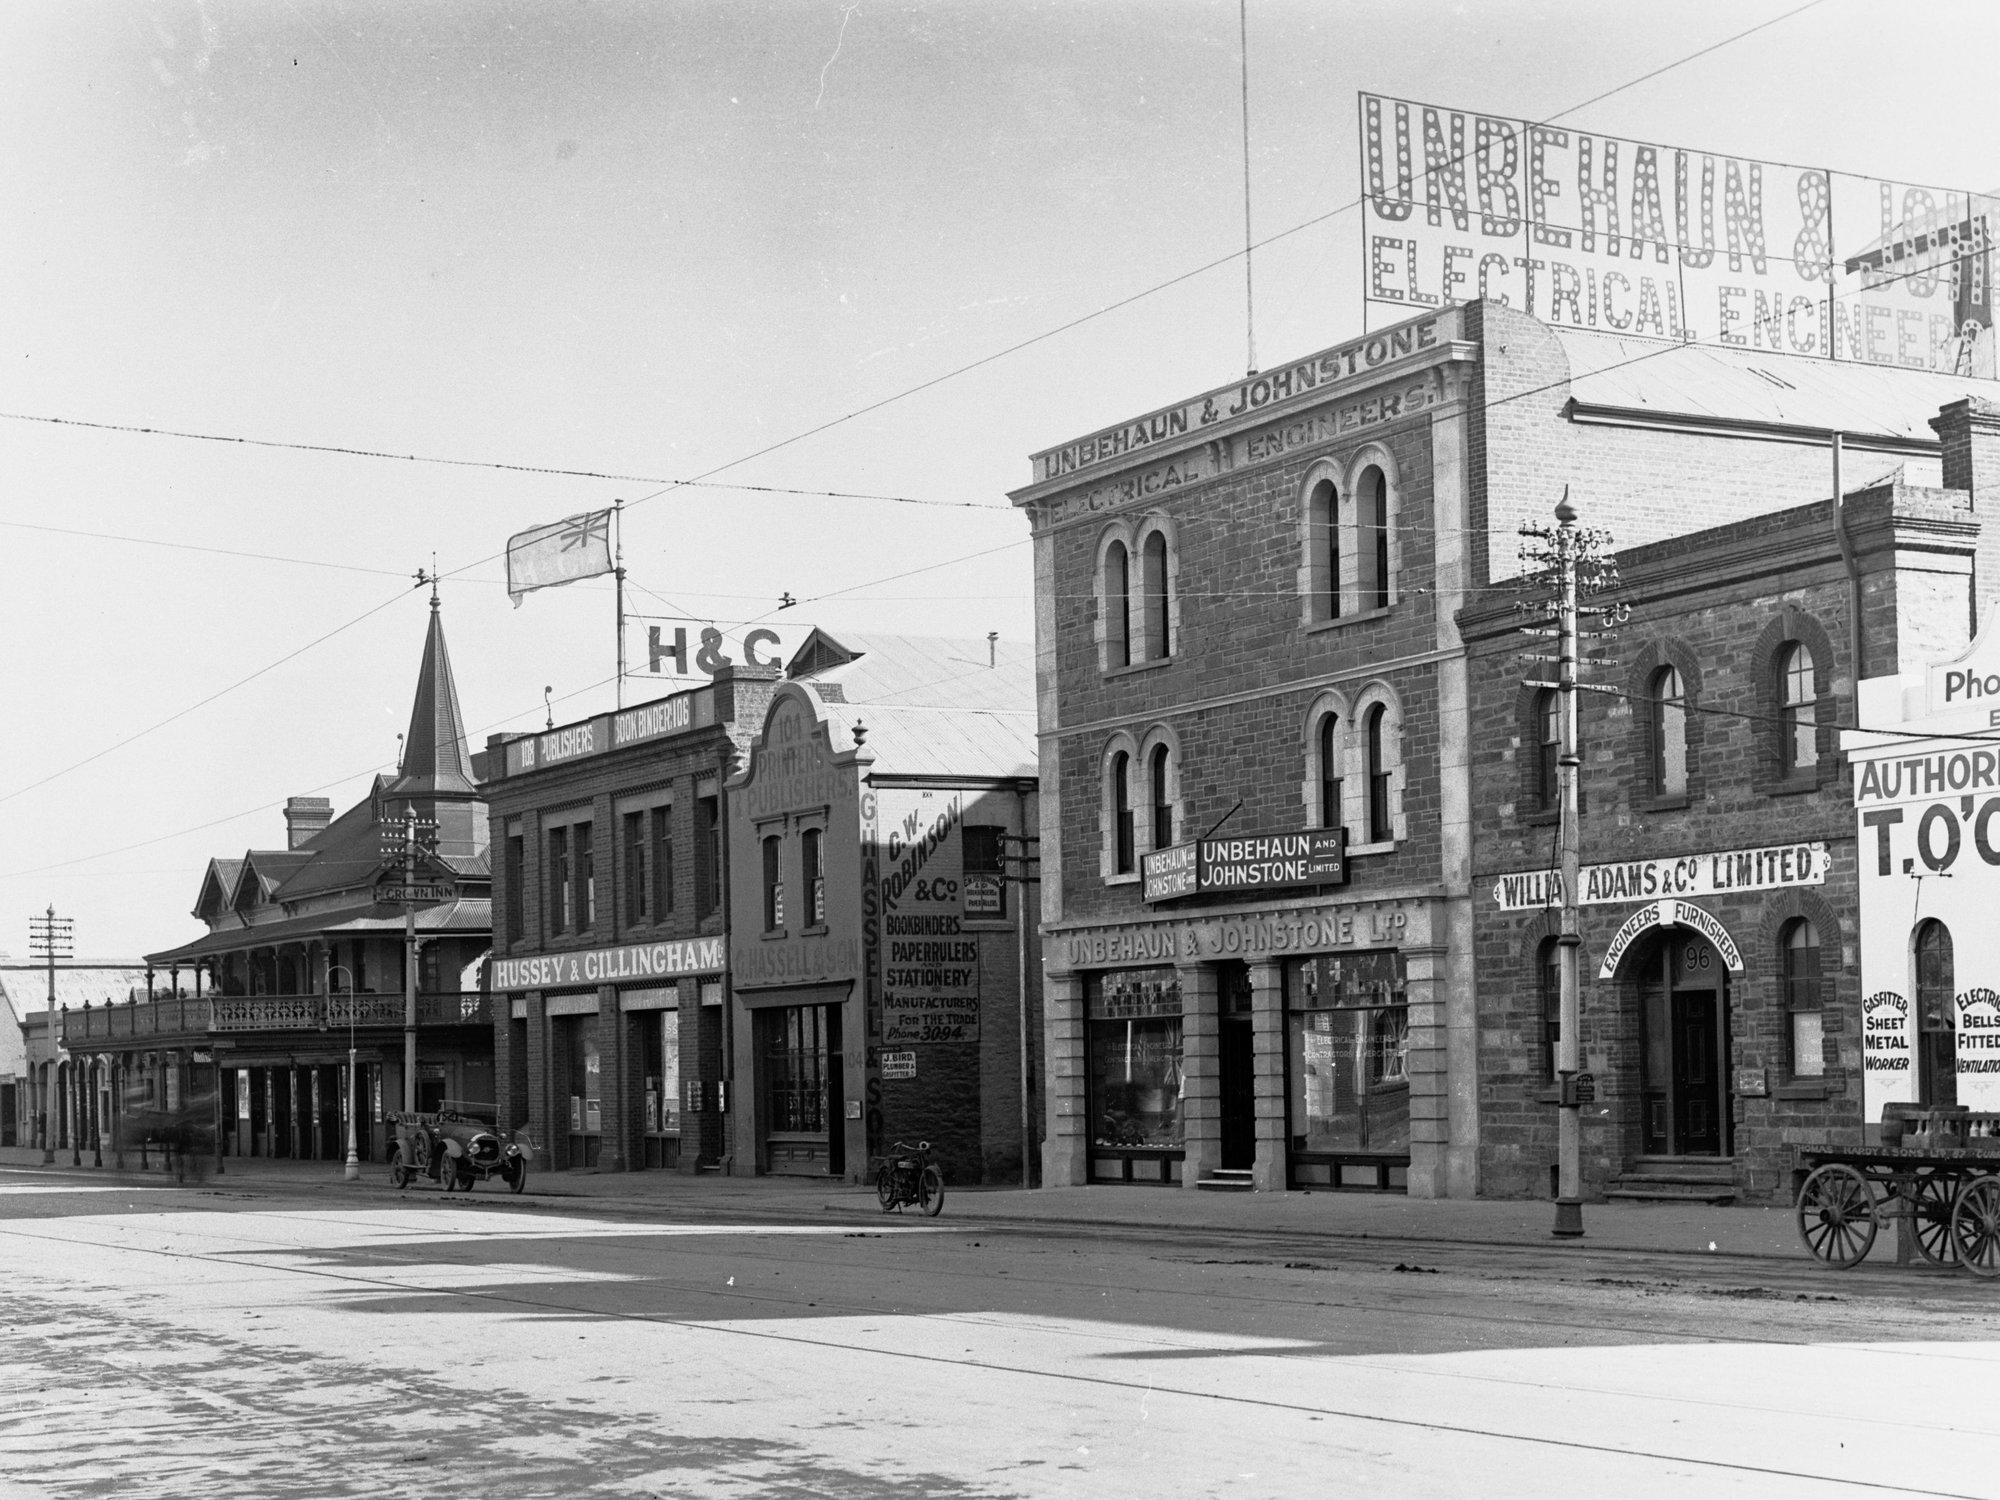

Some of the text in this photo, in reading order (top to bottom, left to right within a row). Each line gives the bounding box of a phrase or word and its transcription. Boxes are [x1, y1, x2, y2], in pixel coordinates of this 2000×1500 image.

[1366, 96, 1768, 277] UNBEHAUN
[1794, 171, 1837, 285] &
[1372, 235, 1697, 340] ELECTRICAL
[1045, 318, 1437, 479] UNBEHAUN & JOHNSTONE
[1050, 459, 1198, 525] ELECTRICAL
[1946, 668, 2000, 703] Pho
[522, 739, 535, 768] 108
[673, 696, 689, 728] 106
[757, 741, 825, 783] PRINTERS
[1858, 748, 2000, 801] AUTHOR
[902, 808, 923, 842] W.
[881, 794, 958, 917] ROBINSON
[1146, 848, 1187, 877] UNBEHAUN
[1203, 835, 1337, 864] UNBEHAUN AND
[1144, 872, 1187, 898] JOHNSTONE
[1200, 860, 1341, 887] JOHNSTONE LIMITED
[1503, 871, 1563, 907] WILLIA
[1587, 862, 1658, 901] ADAMS
[432, 887, 452, 898] INN
[887, 915, 960, 936] BOOKBINDERS
[1069, 934, 1176, 965] UNBEHAUN
[1185, 928, 1199, 955] &
[1210, 915, 1354, 953] JOHNSTONE
[1603, 902, 1661, 973] ENGINEERS
[1675, 903, 1740, 969] FURNISHERS
[496, 956, 563, 988] HUSSEY
[570, 959, 579, 981] &
[583, 939, 718, 980] GILLINGHAM
[1686, 945, 1710, 970] 96
[887, 968, 972, 987] STATIONERY
[885, 991, 978, 1012] MANUFACTURERS
[888, 1026, 920, 1041] Phone
[899, 1013, 977, 1026] FOR THE TRADE
[1866, 1016, 1905, 1030] SHEET
[1963, 1013, 2000, 1029] BELLS
[865, 1046, 878, 1068] &
[1865, 1035, 1909, 1050] METAL
[1865, 1056, 1909, 1071] WORKER
[1793, 1143, 1832, 1154] THOMAS
[1892, 1148, 1922, 1158] SONS
